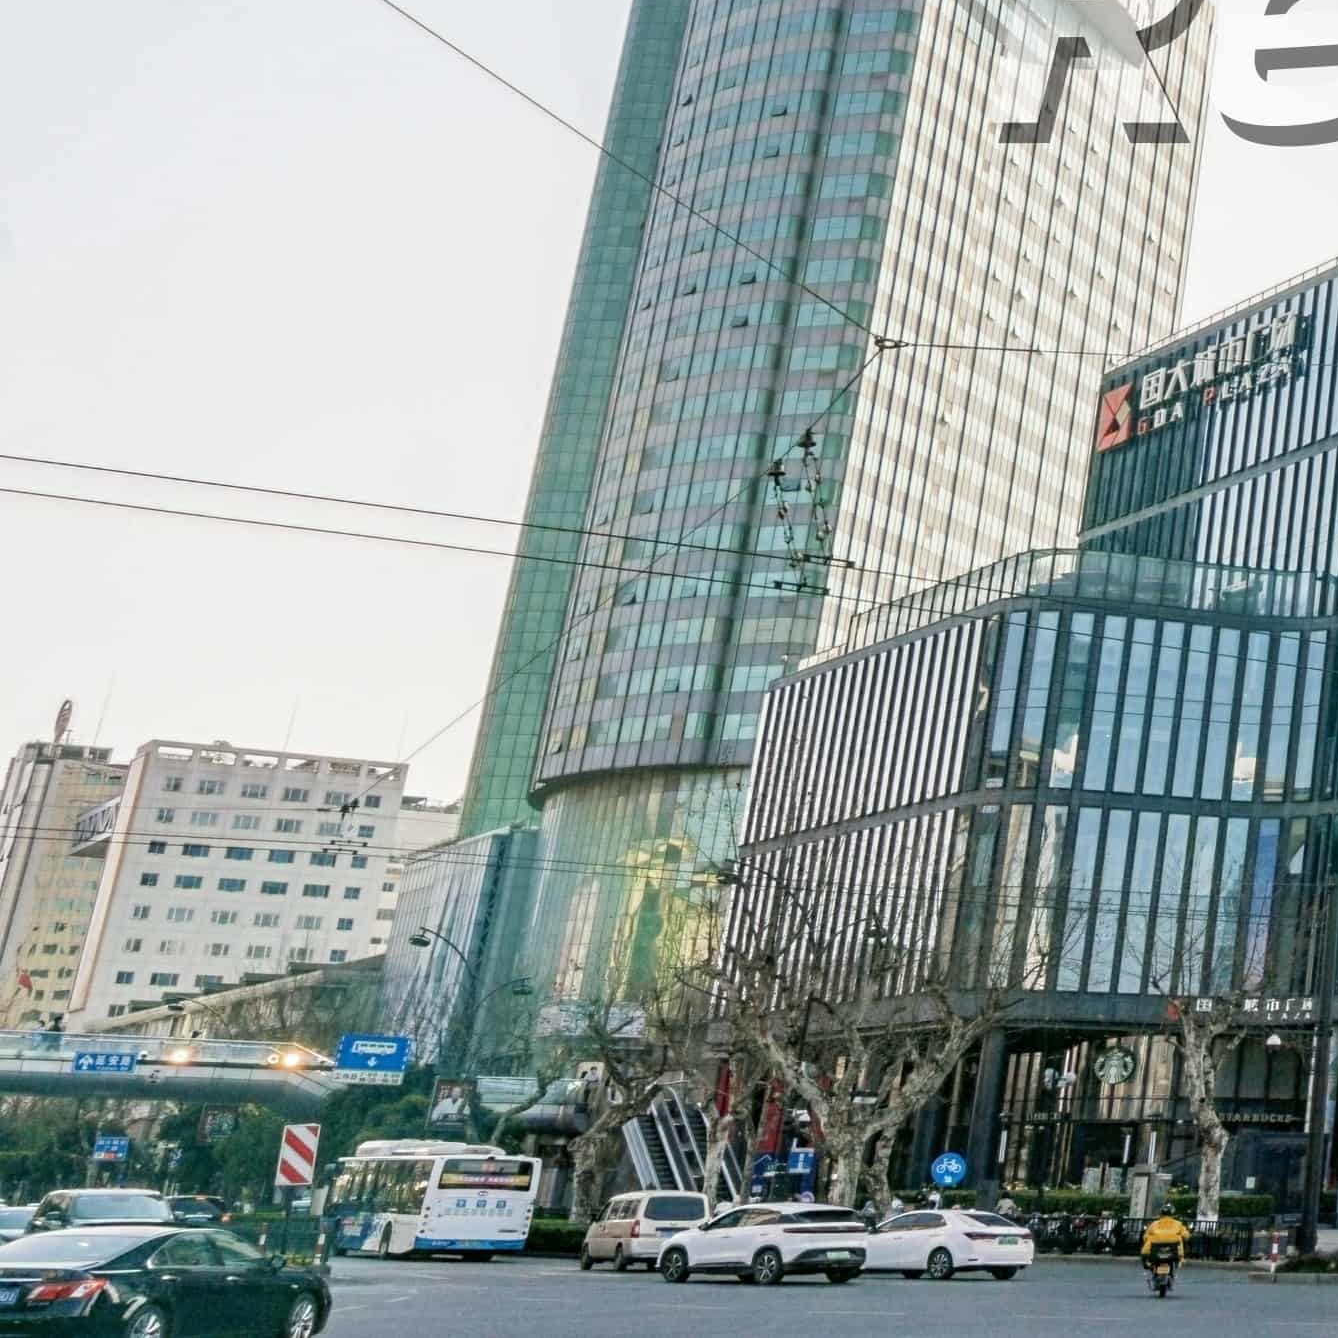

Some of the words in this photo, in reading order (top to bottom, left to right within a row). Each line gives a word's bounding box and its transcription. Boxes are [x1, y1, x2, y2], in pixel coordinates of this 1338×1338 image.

[1203, 355, 1291, 407] PLAZA
[1195, 997, 1313, 1013] 国城市广场
[1266, 1012, 1311, 1021] LAZA
